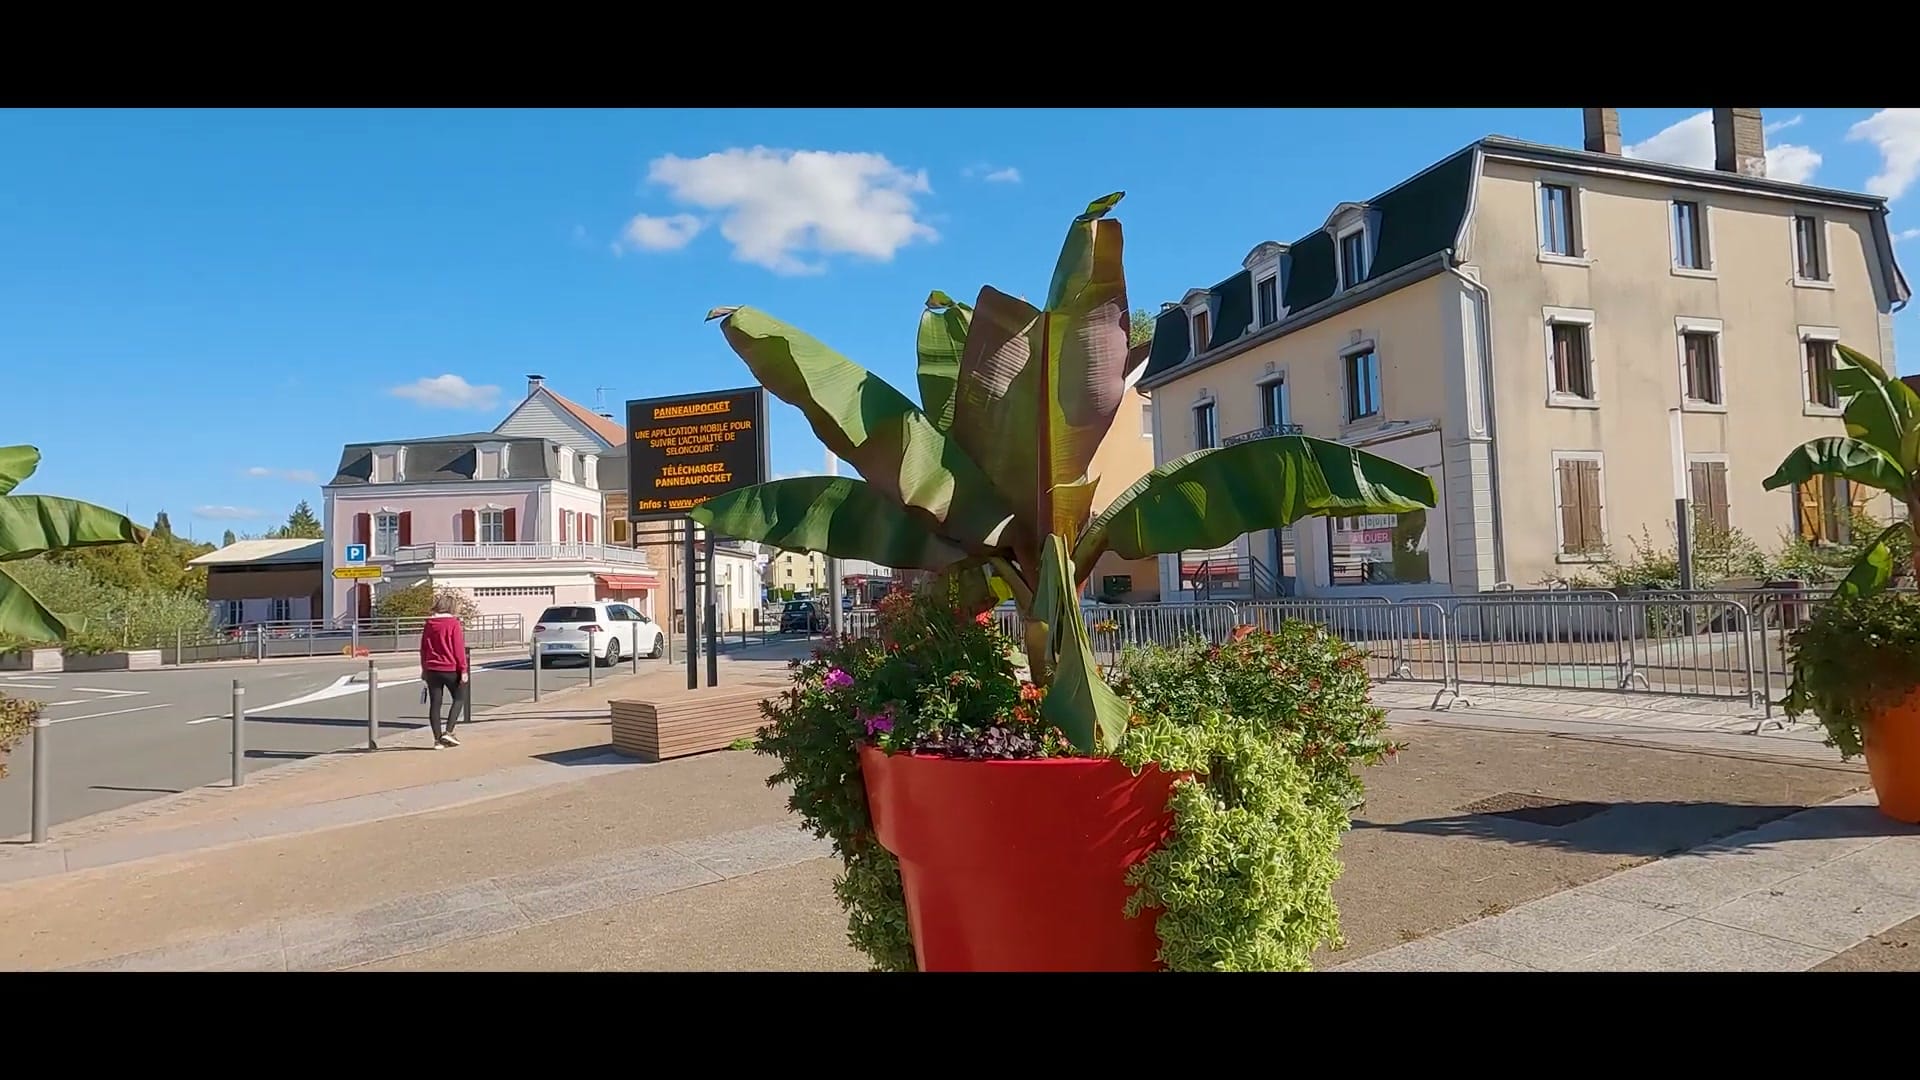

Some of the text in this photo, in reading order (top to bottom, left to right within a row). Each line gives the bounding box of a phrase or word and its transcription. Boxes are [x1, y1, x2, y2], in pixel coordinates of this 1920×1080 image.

[654, 401, 731, 419] PANNEAUPOCKET
[635, 421, 752, 439] UNE APPLICATION MOBILE POUR
[650, 432, 736, 448] SUIVRE L'ACTUALITÉ DE
[666, 444, 714, 456] SELONCOURT
[662, 462, 725, 476] TÉLÉCHARGEZ
[655, 473, 732, 488] PANNEAUPOCKET
[639, 499, 662, 510] Infos
